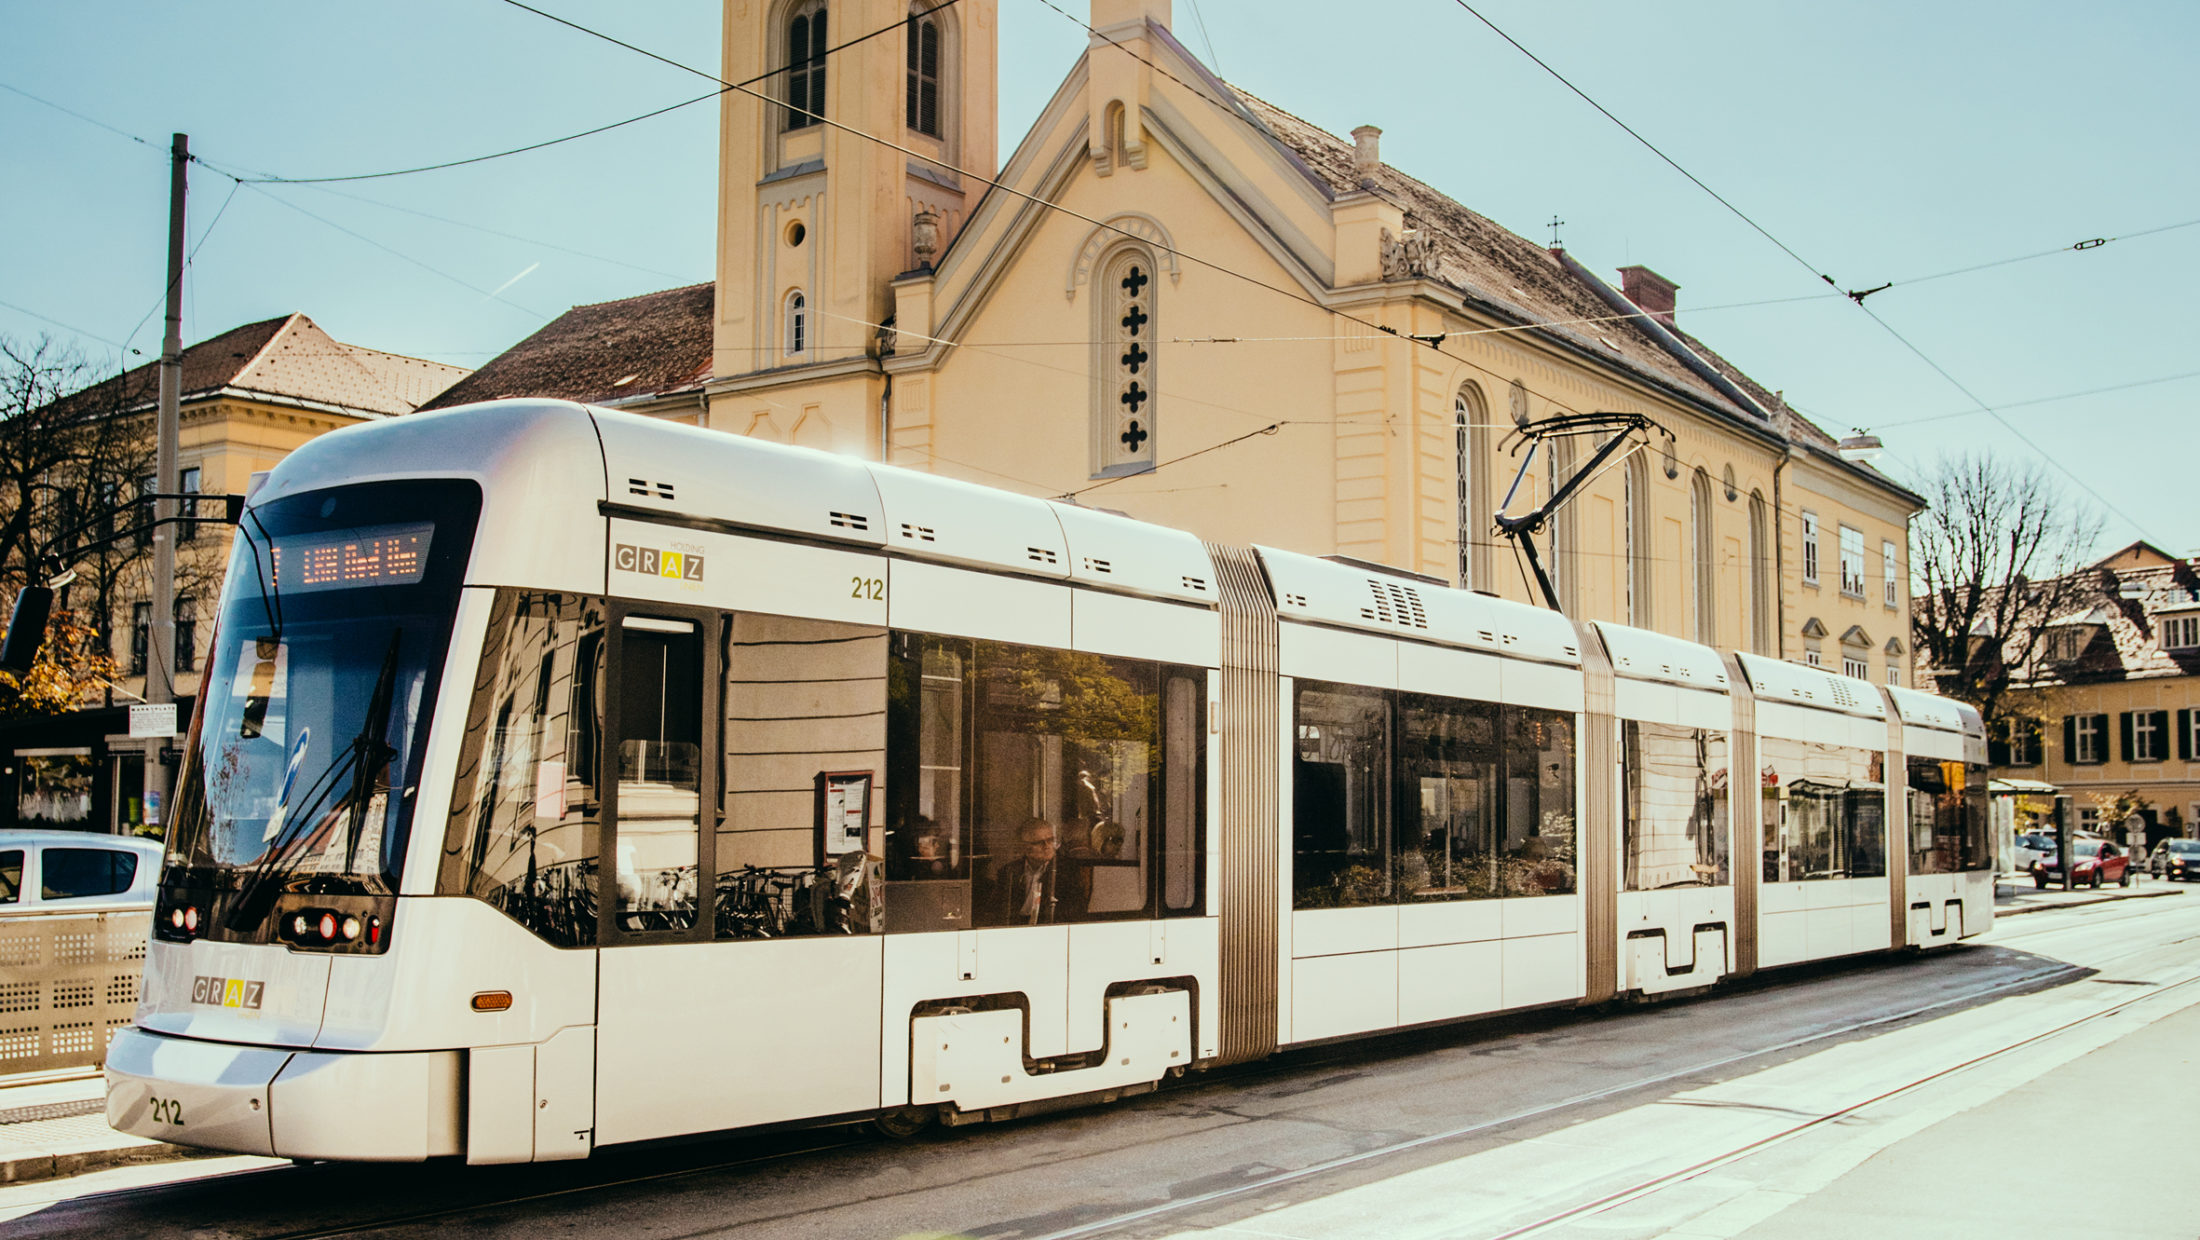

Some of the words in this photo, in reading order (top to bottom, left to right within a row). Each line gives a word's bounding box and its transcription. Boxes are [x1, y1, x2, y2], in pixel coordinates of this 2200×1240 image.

[616, 545, 702, 581] GRAZ
[851, 576, 884, 601] 212
[193, 977, 262, 1008] GRAZ
[150, 1096, 185, 1126] 212
